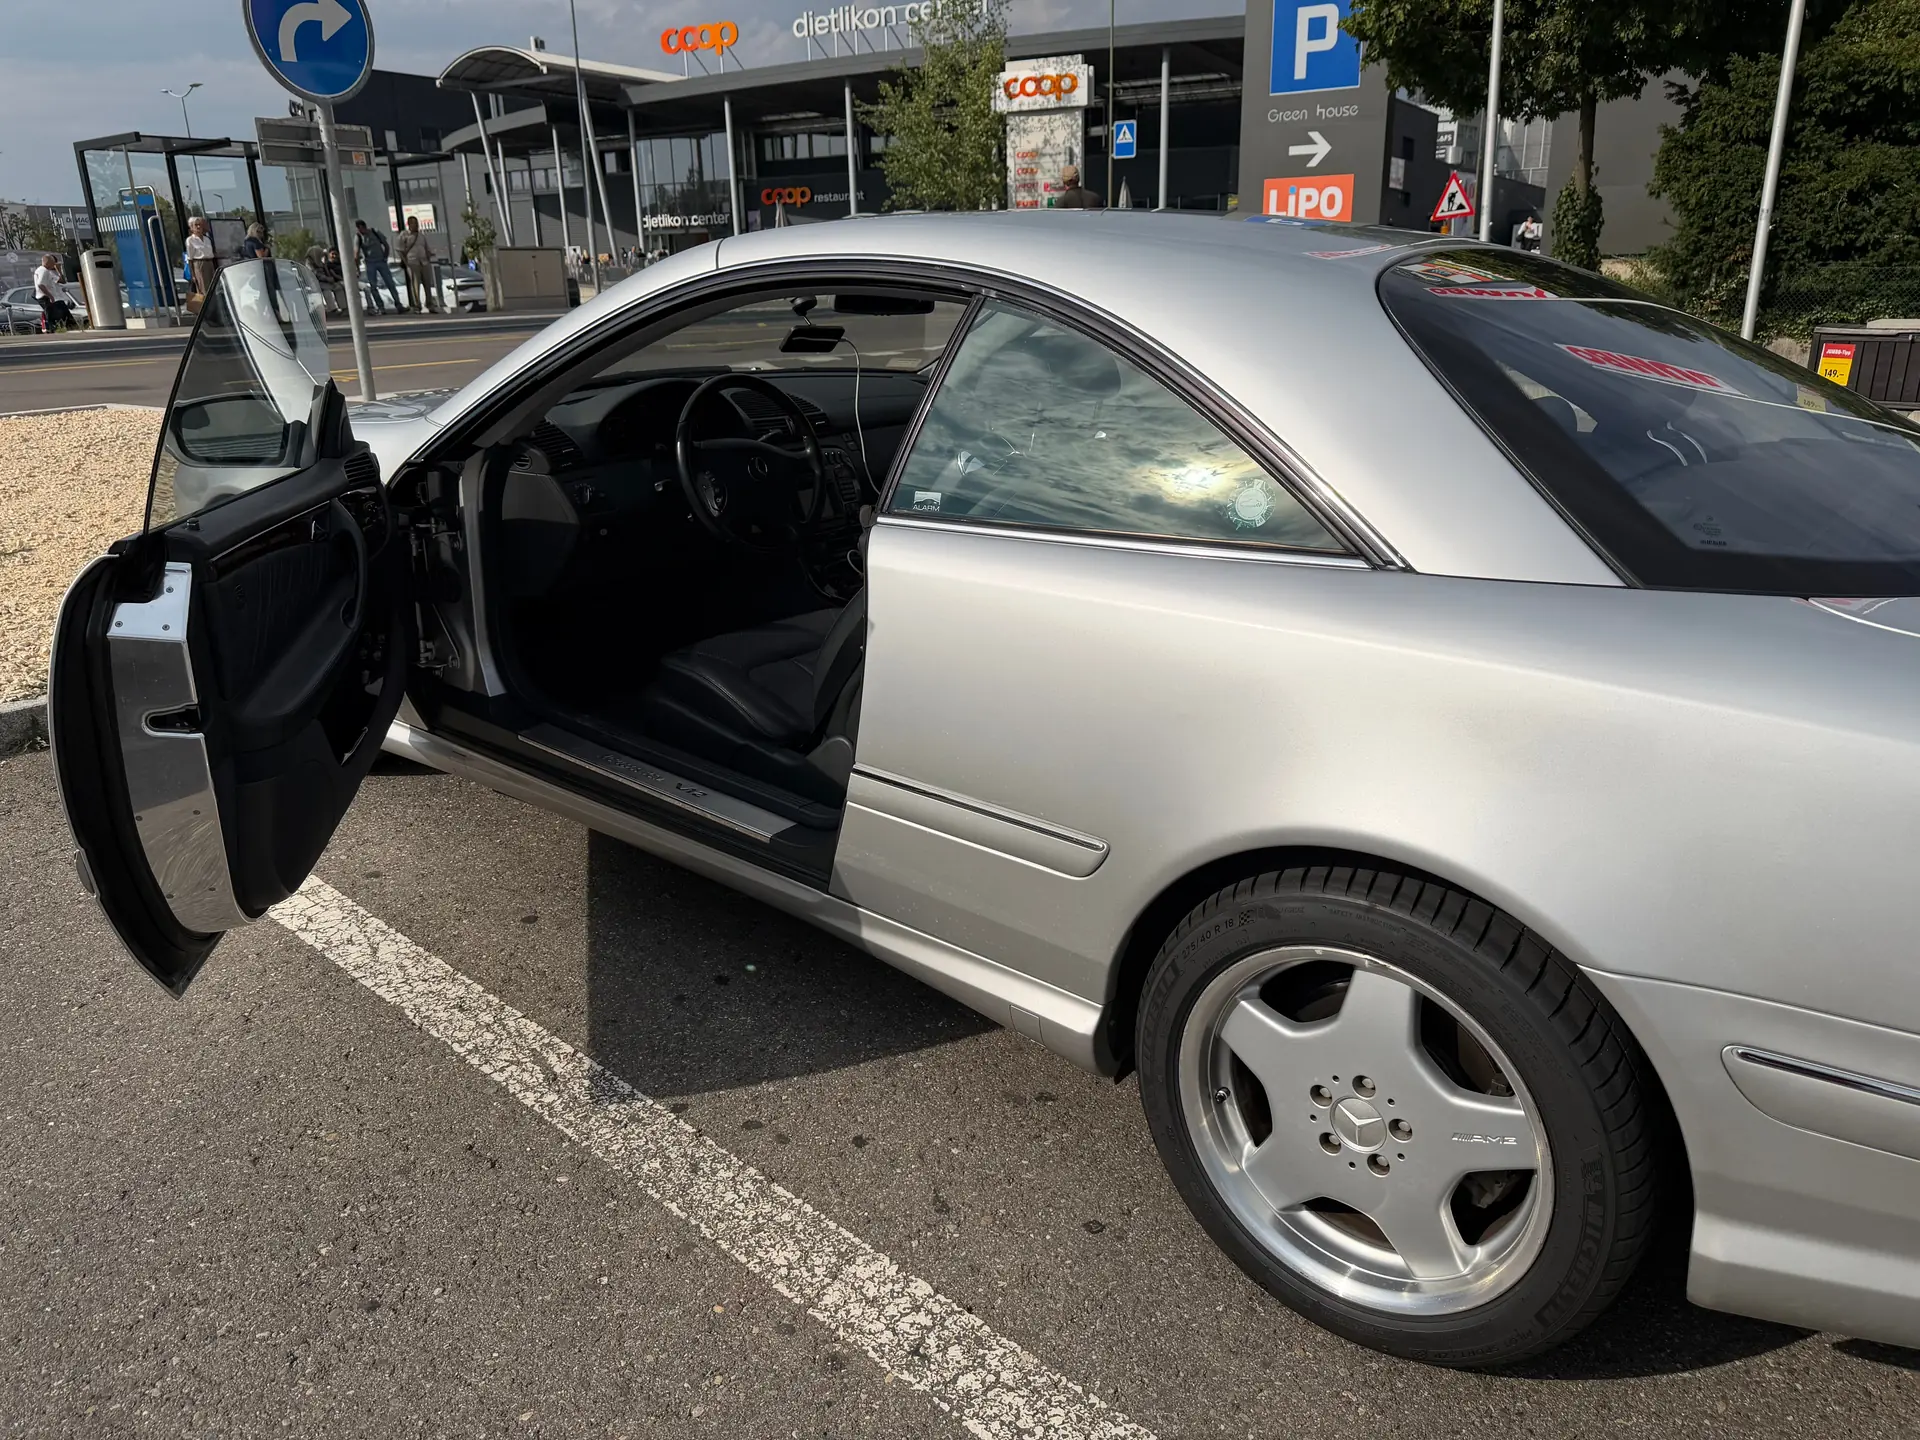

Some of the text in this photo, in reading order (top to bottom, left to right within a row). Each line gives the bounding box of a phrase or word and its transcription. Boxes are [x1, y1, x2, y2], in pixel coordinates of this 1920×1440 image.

[793, 0, 991, 39] dietlikon cer
[660, 20, 739, 55] coop
[1294, 3, 1340, 80] P
[1003, 73, 1078, 101] coop
[1267, 104, 1359, 123] Green house
[761, 186, 811, 207] coop
[814, 191, 865, 203] restaurnt
[690, 211, 730, 226] center
[1182, 930, 1212, 960] 275/40
[1224, 918, 1234, 929] 18
